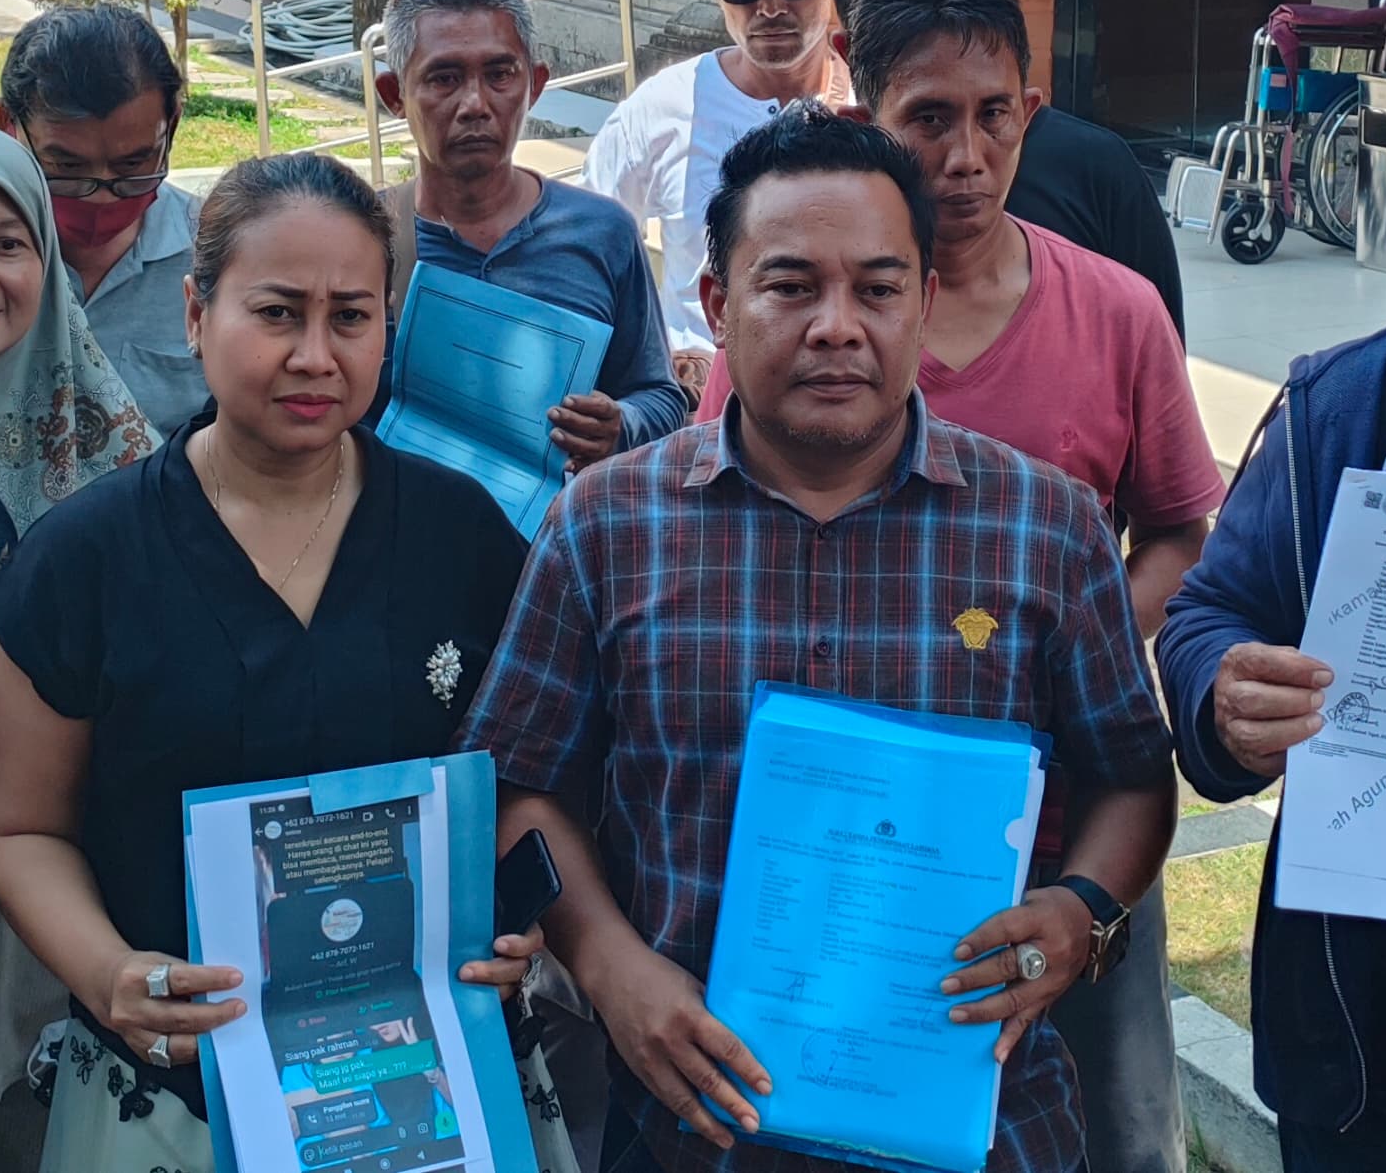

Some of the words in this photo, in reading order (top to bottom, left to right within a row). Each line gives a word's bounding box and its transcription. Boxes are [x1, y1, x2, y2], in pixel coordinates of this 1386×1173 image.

[1327, 810, 1351, 830] ah
[284, 1048, 311, 1062] Siang
[311, 1044, 327, 1058] pak
[327, 1038, 359, 1054] rahman
[315, 1065, 340, 1079] Siang
